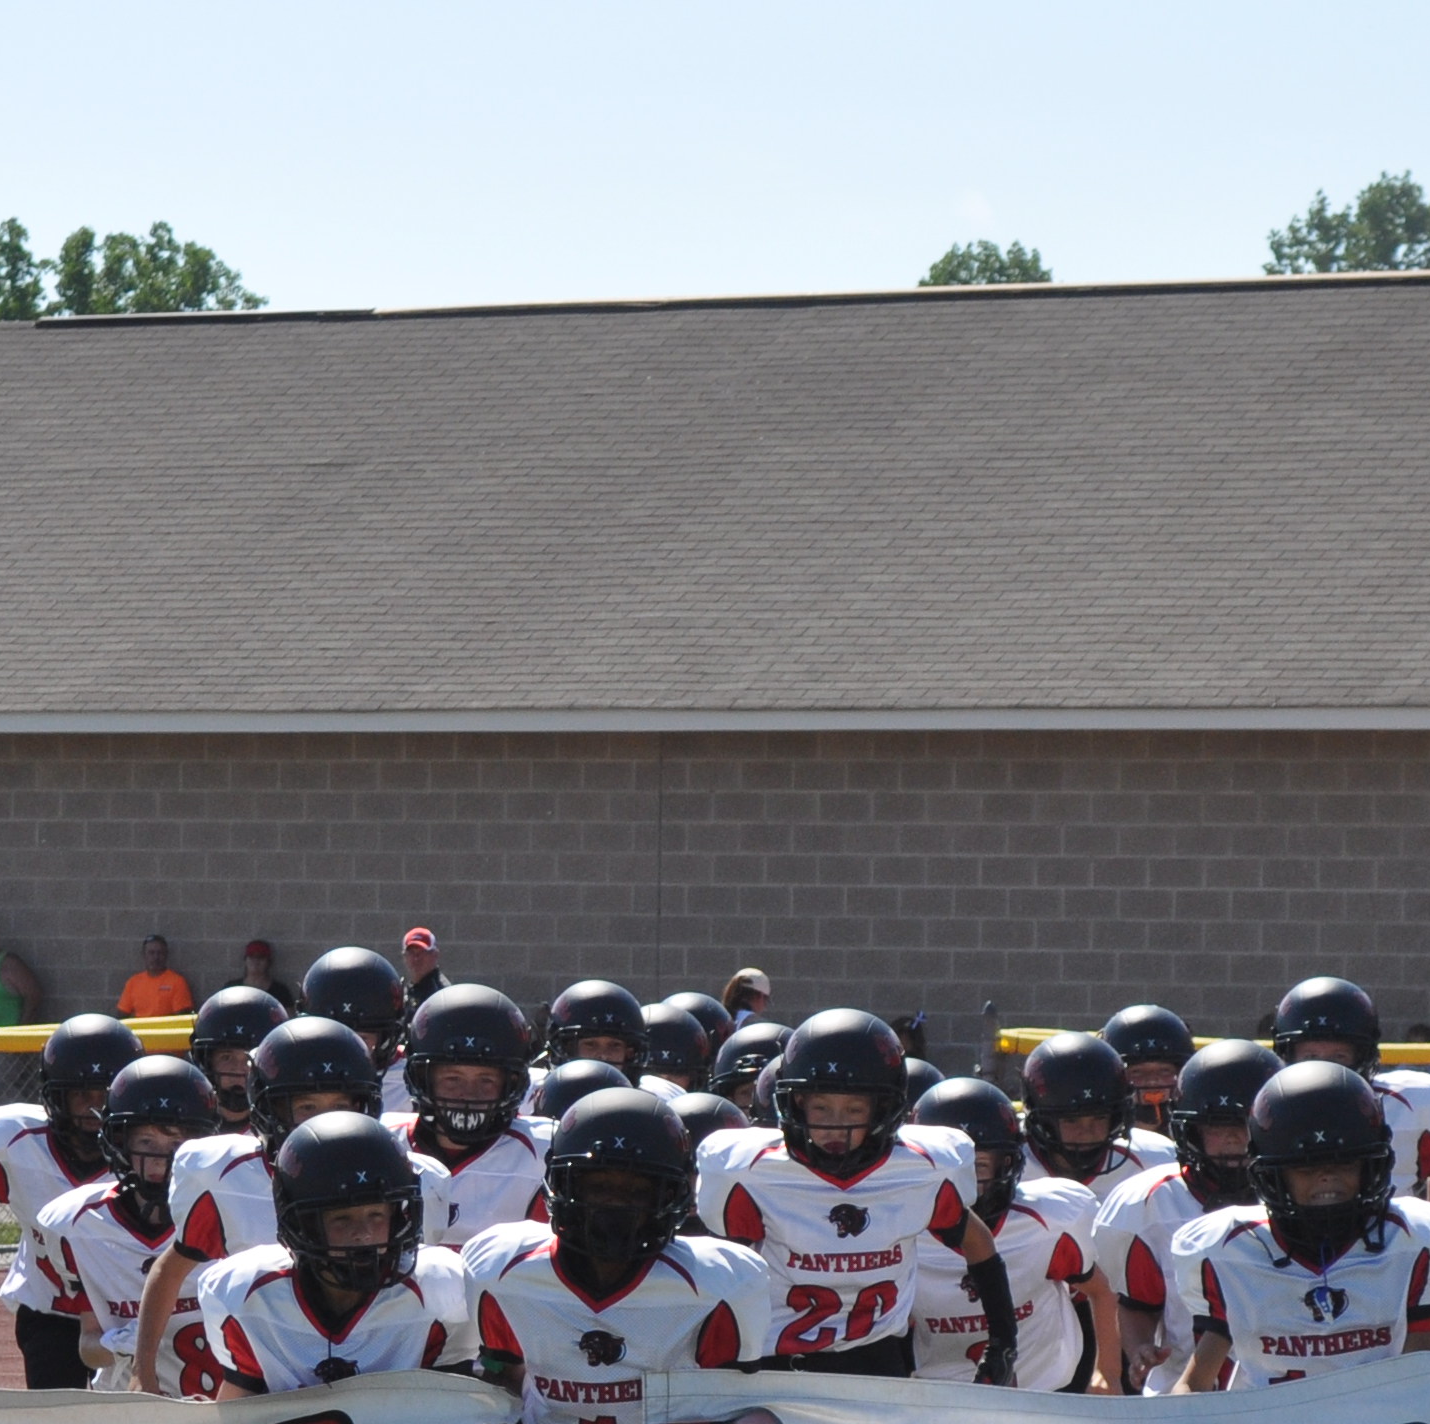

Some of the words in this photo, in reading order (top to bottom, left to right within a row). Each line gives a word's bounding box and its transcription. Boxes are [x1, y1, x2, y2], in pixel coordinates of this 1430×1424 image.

[787, 1243, 903, 1273] PANTHERS
[775, 1280, 899, 1356] 20
[1260, 1326, 1392, 1357] PANTHERS
[534, 1375, 643, 1404] PANTHE
